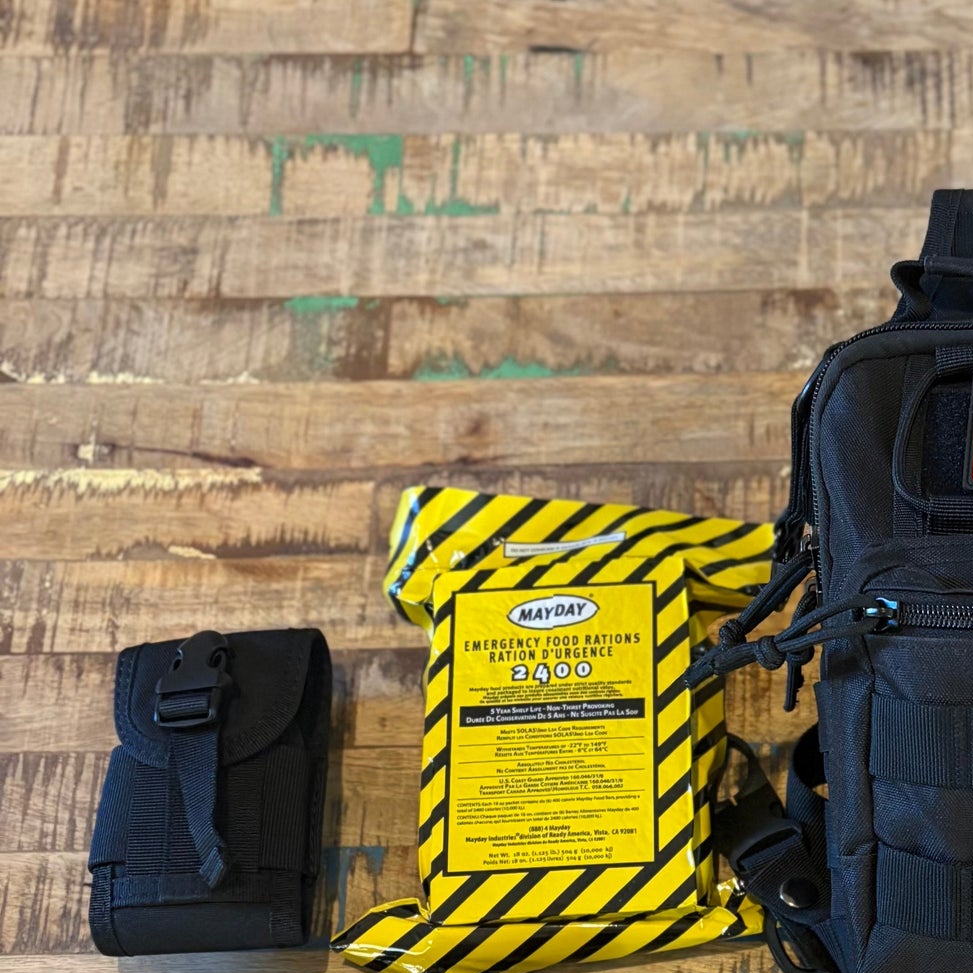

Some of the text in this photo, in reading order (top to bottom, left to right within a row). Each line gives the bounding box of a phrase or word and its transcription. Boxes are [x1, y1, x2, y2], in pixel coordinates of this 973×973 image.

[518, 604, 586, 621] MAYDAY
[464, 632, 640, 651] EMERGENCY FOOD RATIONS
[489, 645, 612, 663] RATION D'URGENCE
[512, 662, 592, 684] 2400
